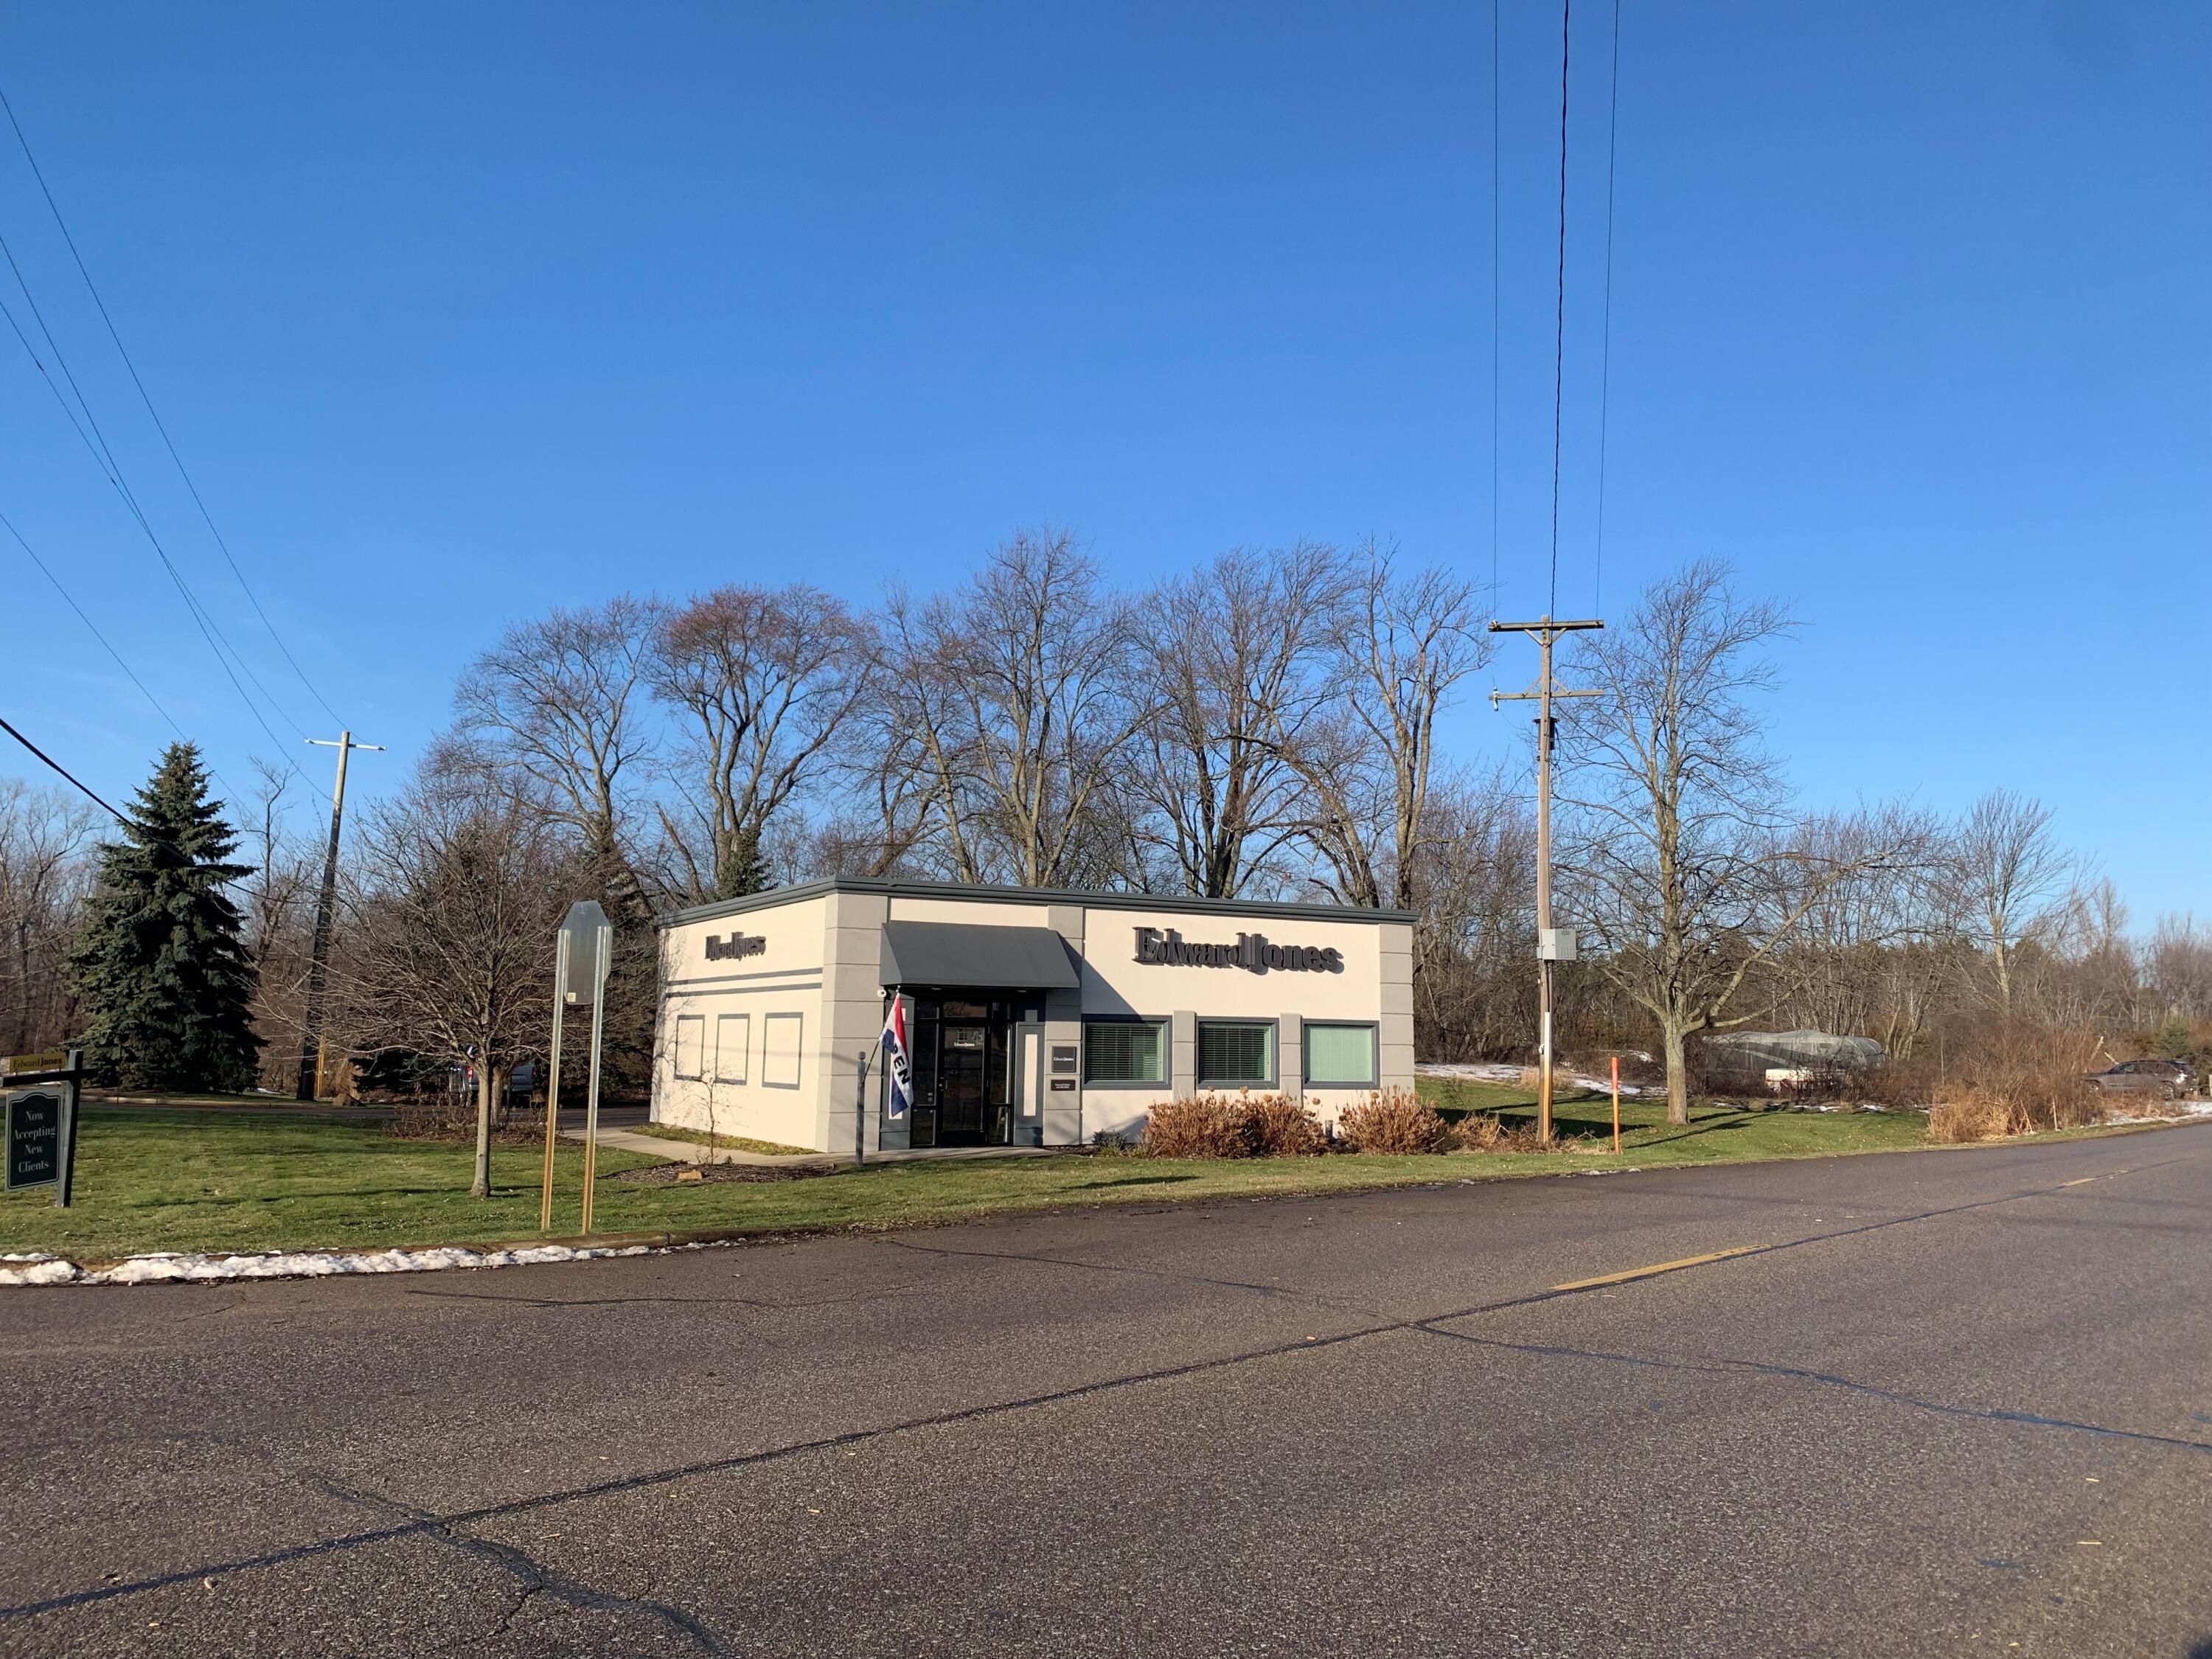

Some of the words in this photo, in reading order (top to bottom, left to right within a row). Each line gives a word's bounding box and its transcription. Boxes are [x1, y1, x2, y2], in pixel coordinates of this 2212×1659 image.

[1132, 926, 1246, 968] Edward
[1248, 933, 1344, 975] Jones
[41, 1057, 62, 1067] Jones
[893, 1043, 911, 1085] PEN
[25, 1110, 44, 1121] Now
[13, 1126, 56, 1141] Accepting
[24, 1144, 43, 1155] New
[18, 1161, 49, 1173] Clients
